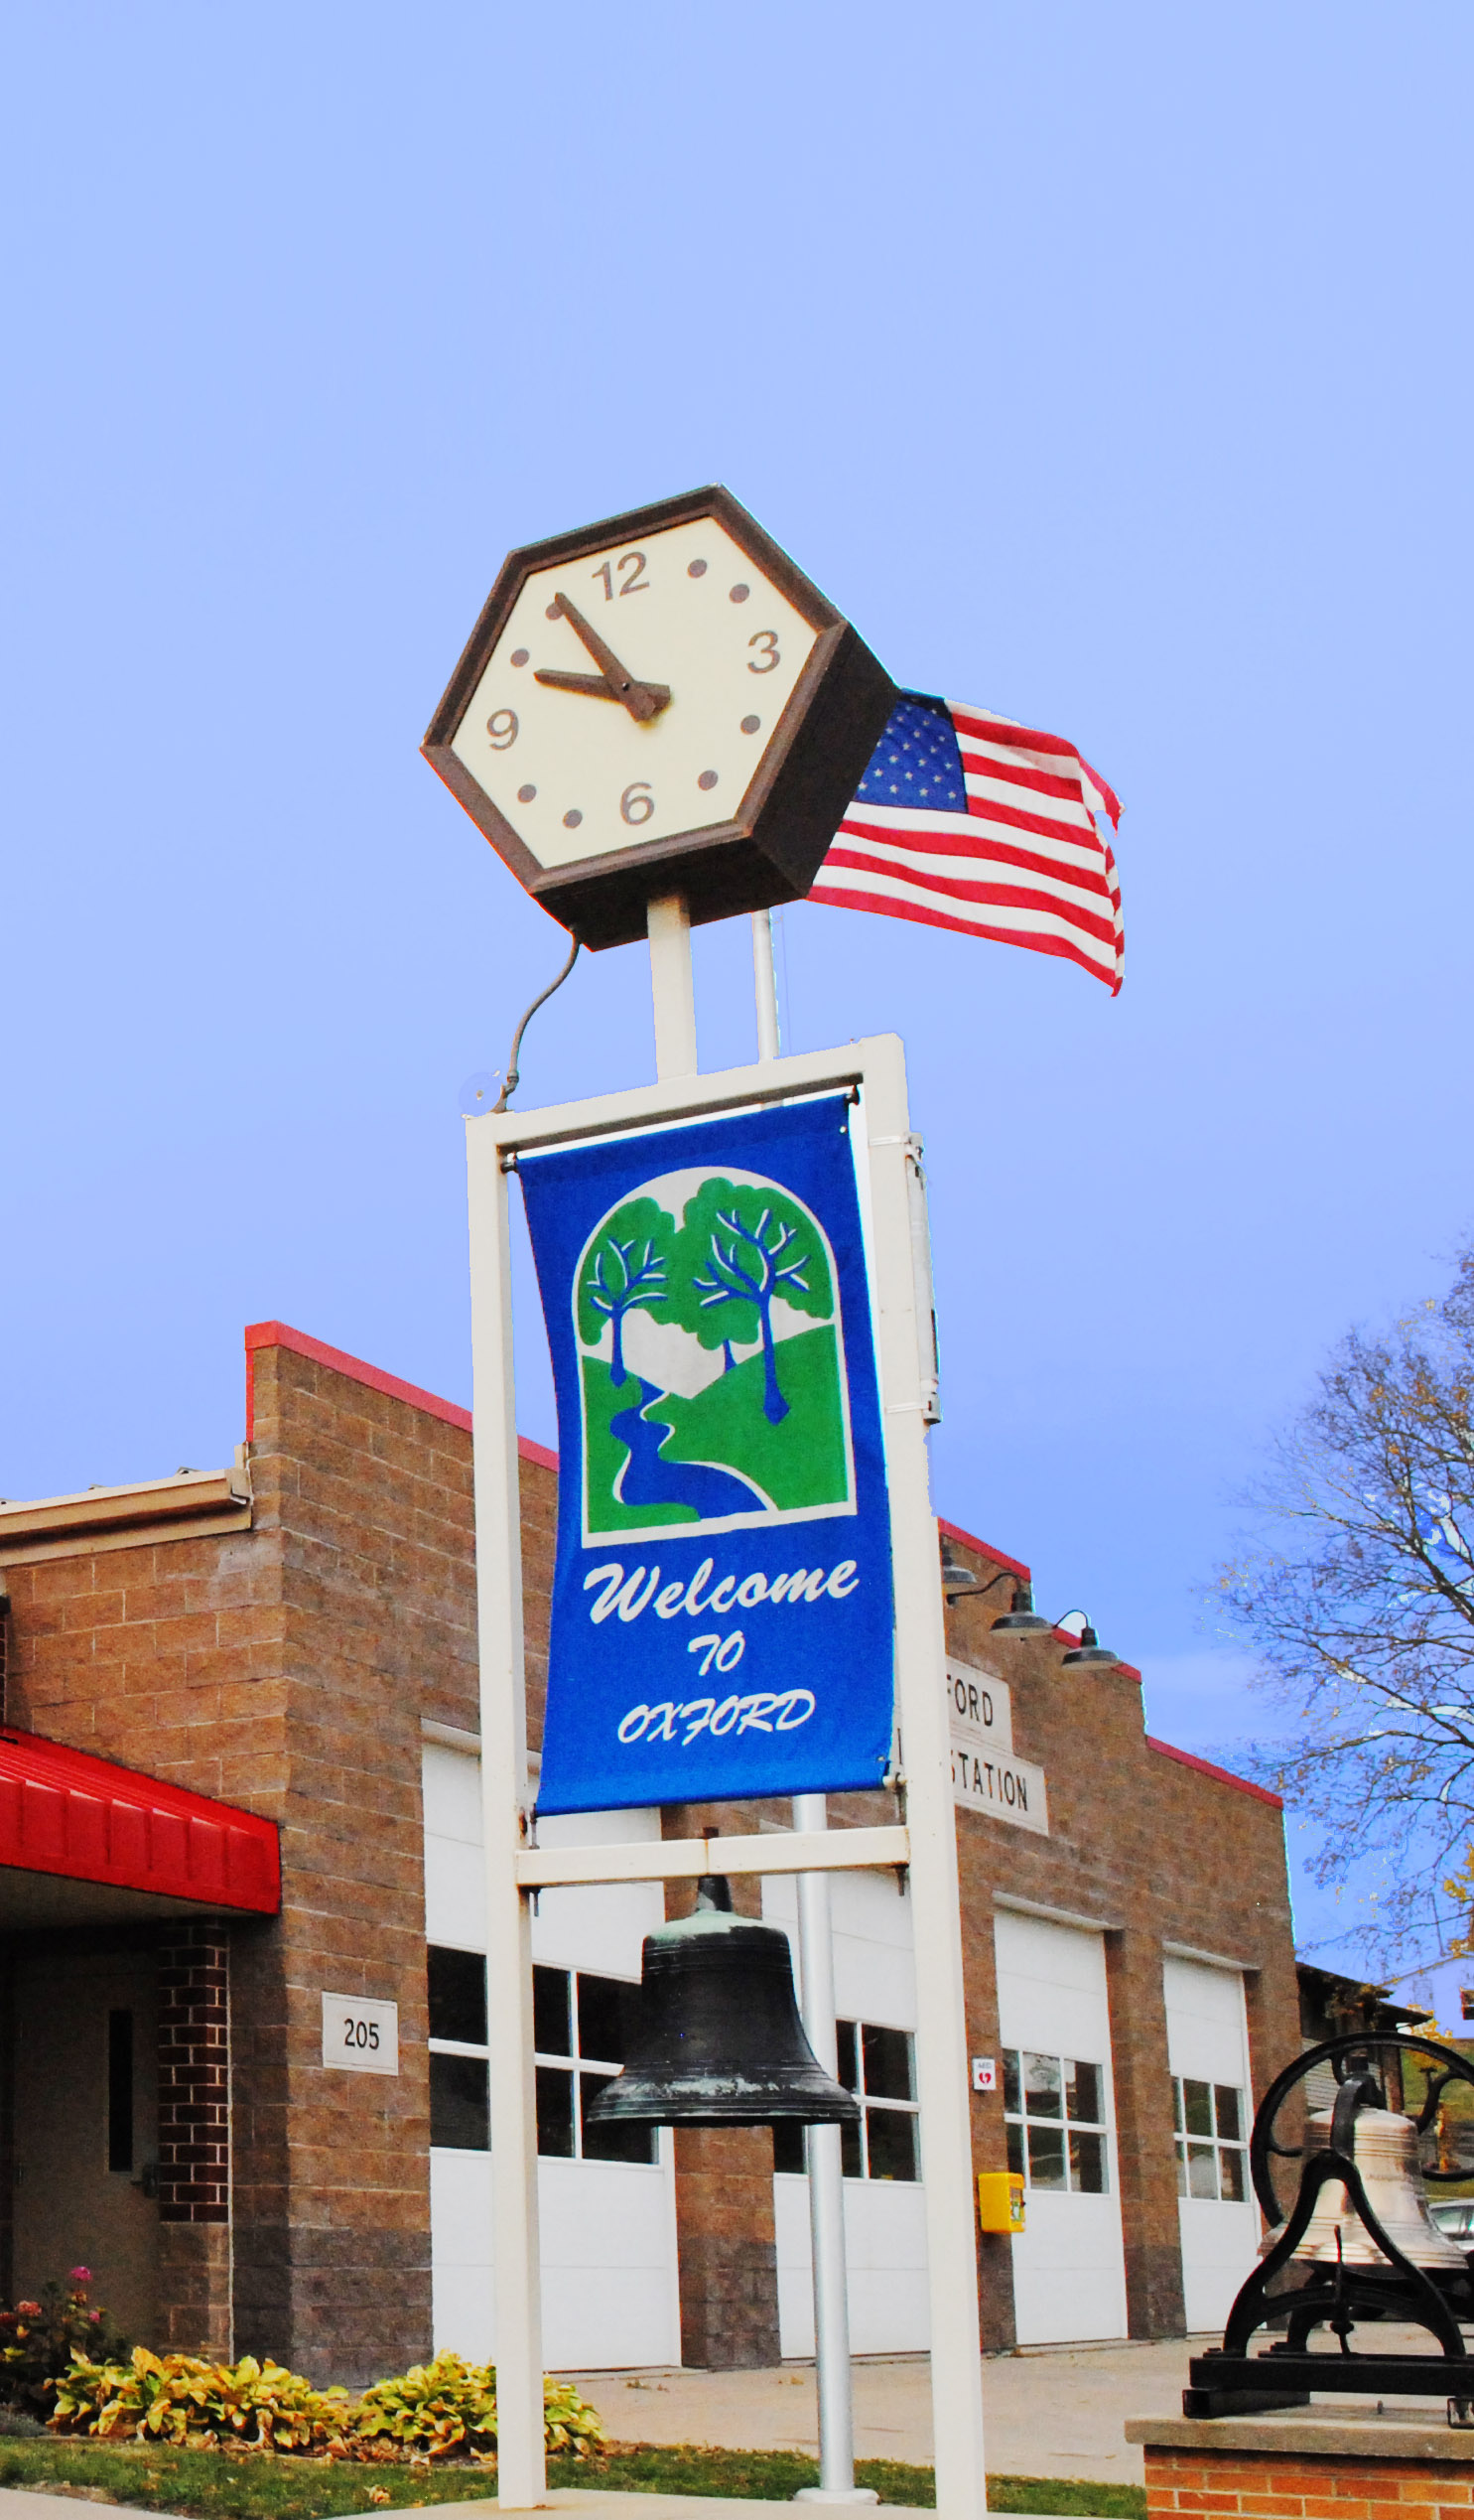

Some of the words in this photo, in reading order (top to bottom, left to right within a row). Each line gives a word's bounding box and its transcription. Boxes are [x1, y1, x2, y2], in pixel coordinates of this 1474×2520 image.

[592, 551, 650, 602] 12
[746, 630, 781, 674] 3
[486, 709, 519, 751] 9
[619, 782, 655, 825] 6
[583, 1557, 860, 1624] Welcome
[687, 1629, 744, 1676] TO
[617, 1689, 815, 1747] OXFORD
[950, 1750, 1027, 1812] TATION
[343, 2018, 379, 2050] 205
